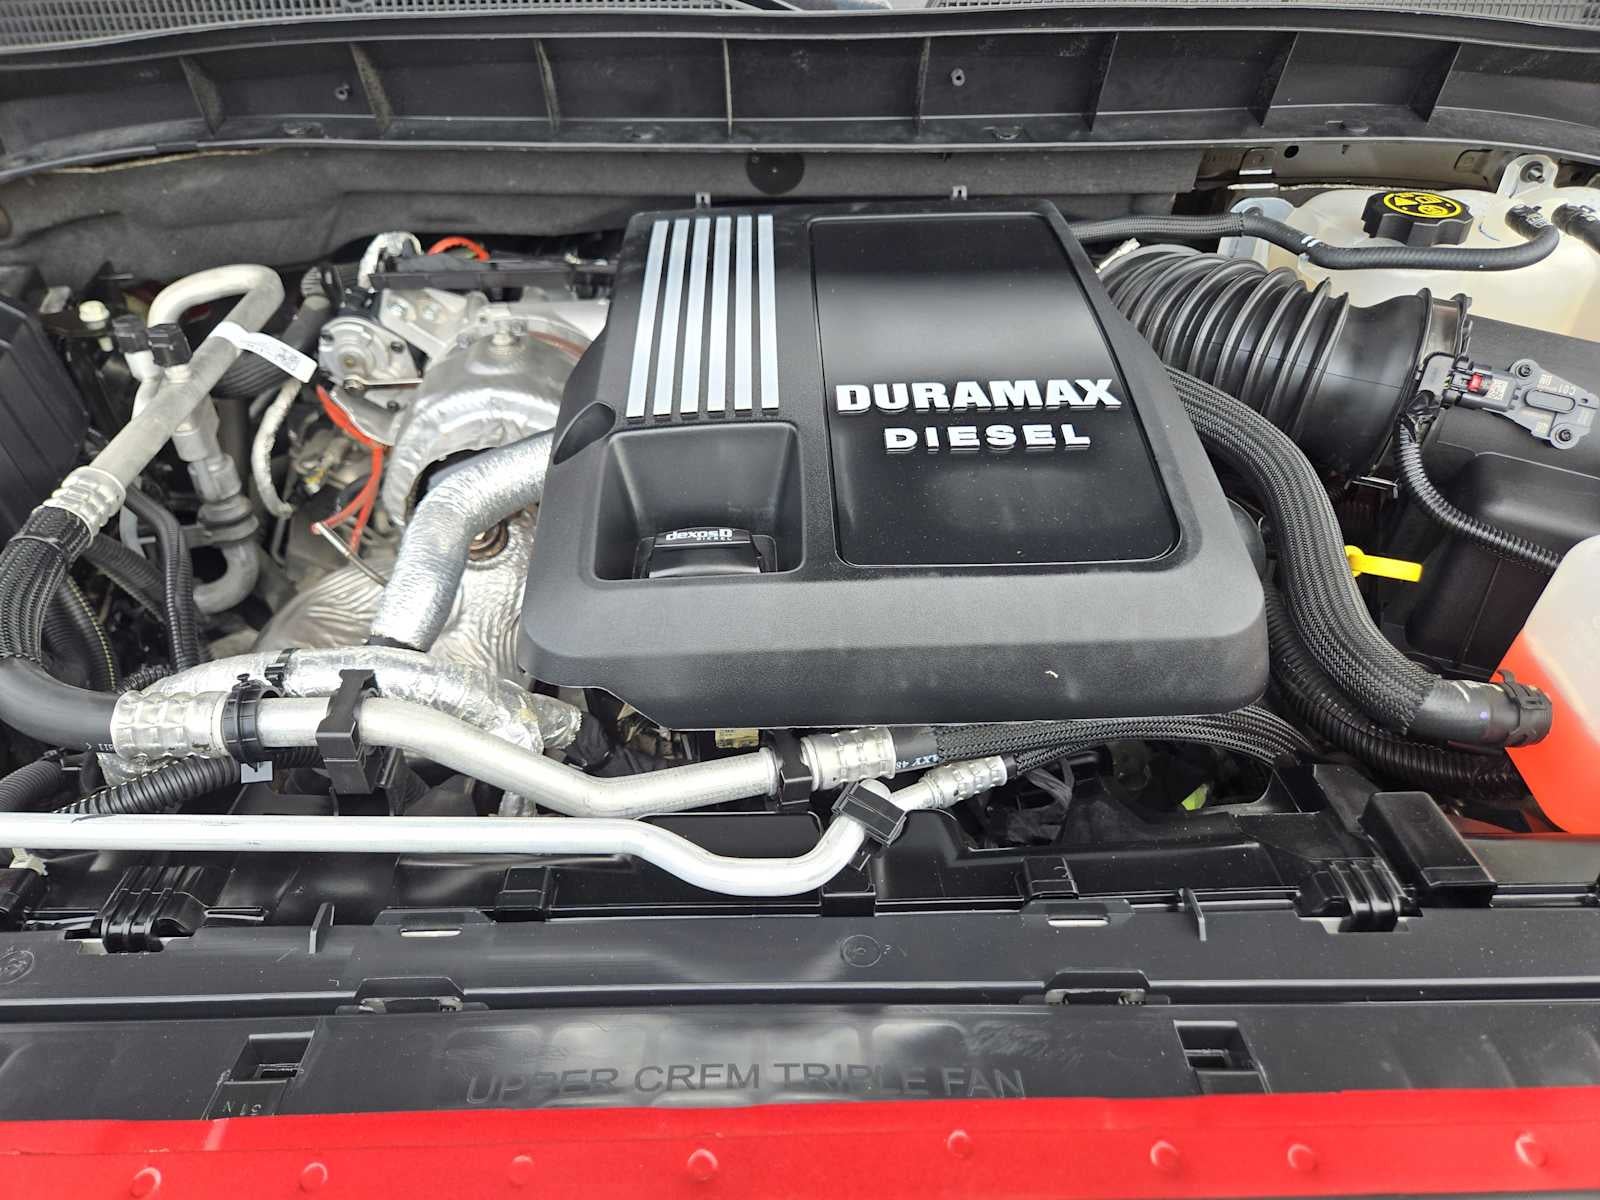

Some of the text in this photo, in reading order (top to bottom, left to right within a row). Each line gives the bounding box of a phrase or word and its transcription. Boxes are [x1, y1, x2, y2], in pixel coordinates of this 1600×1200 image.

[836, 379, 1122, 412] DURAMAX
[884, 424, 1091, 453] DIESEL
[466, 1068, 621, 1104] UPPER
[772, 1063, 929, 1095] TRIPLE
[939, 1066, 1027, 1099] FAN
